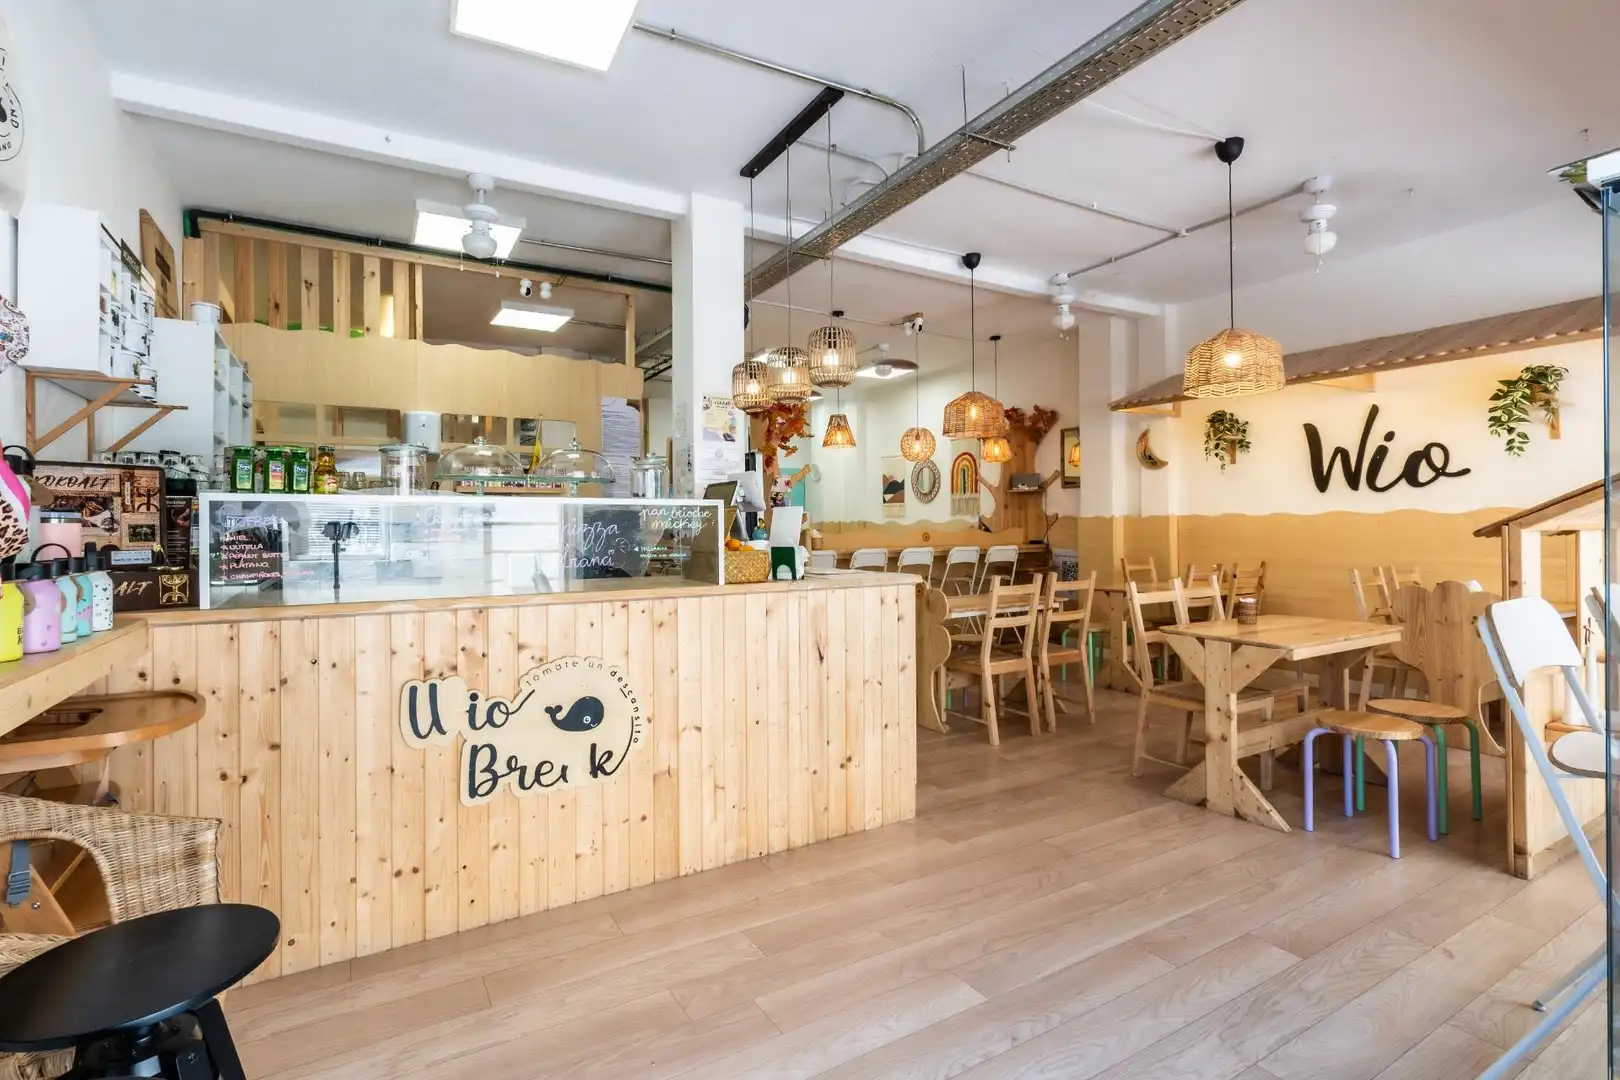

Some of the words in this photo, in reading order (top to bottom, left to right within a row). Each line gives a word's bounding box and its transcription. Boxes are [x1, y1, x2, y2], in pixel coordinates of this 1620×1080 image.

[1302, 403, 1472, 493] Wio
[638, 507, 669, 521] pan
[670, 506, 712, 519] brioche
[609, 669, 642, 744] descansito
